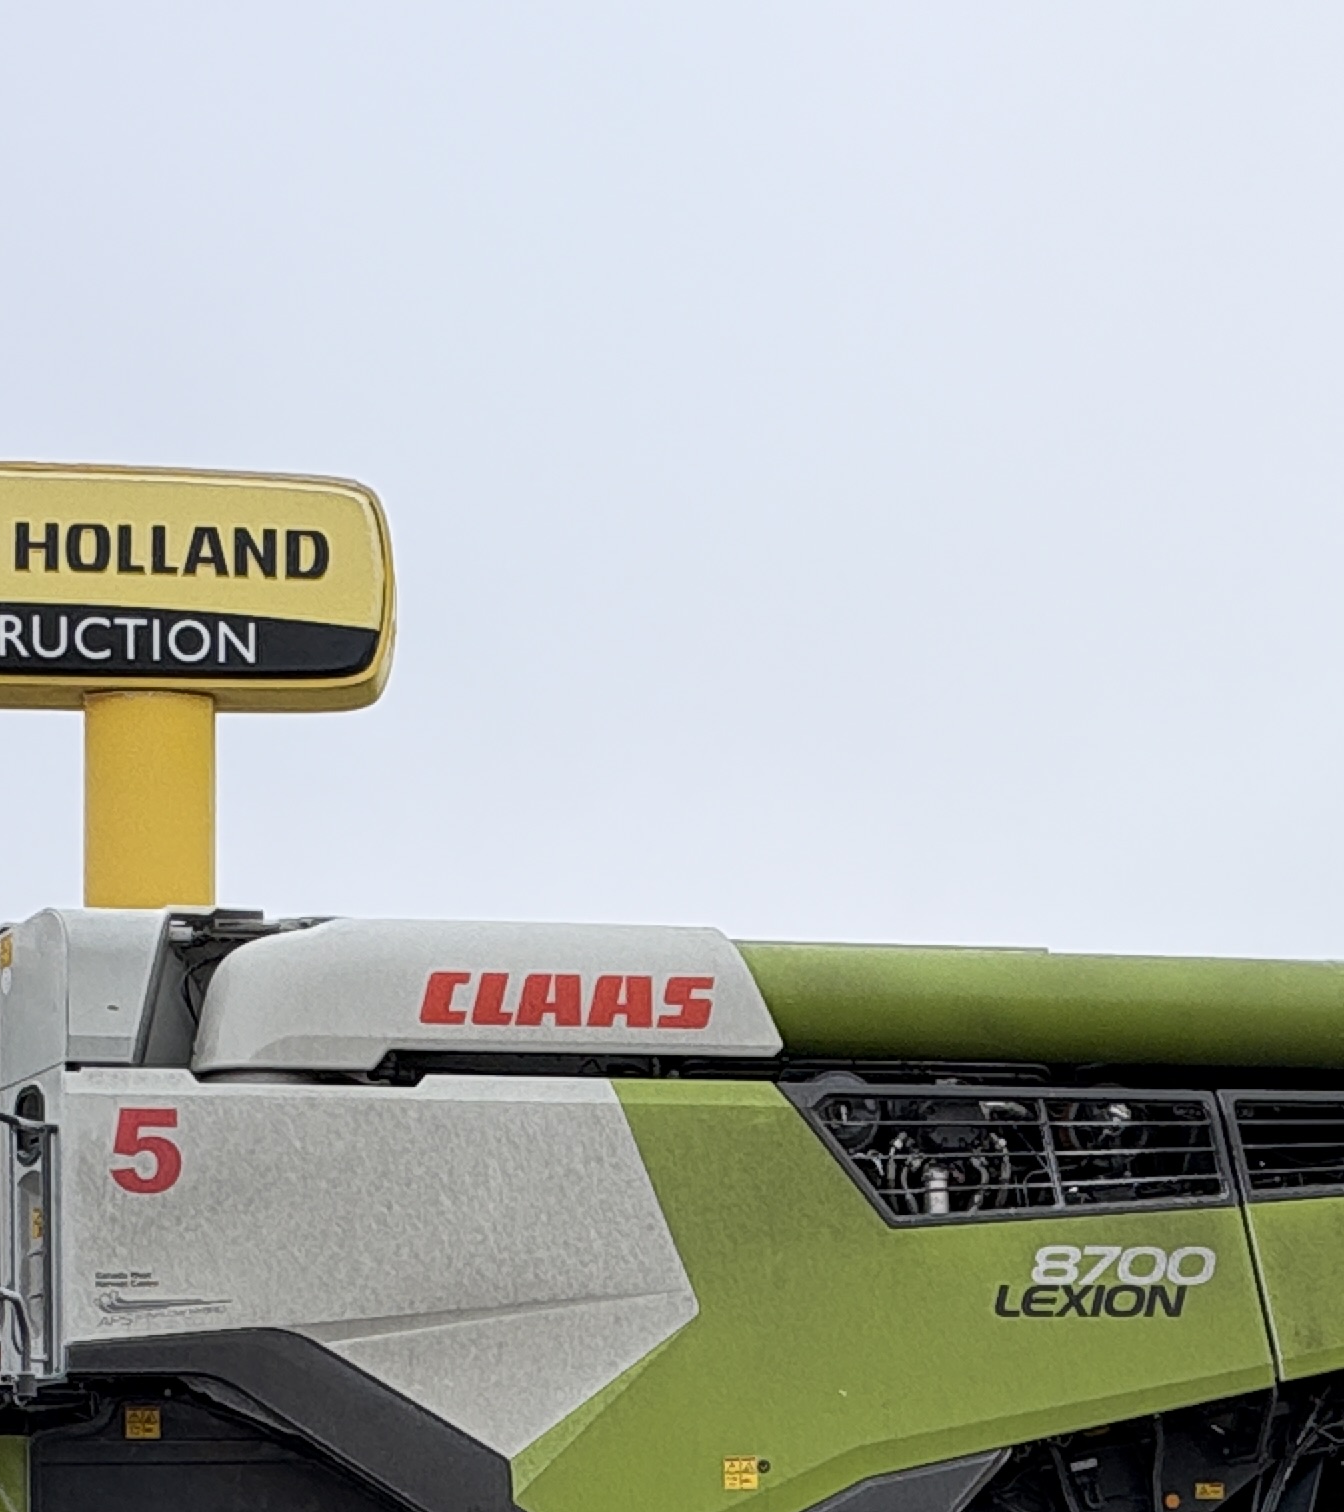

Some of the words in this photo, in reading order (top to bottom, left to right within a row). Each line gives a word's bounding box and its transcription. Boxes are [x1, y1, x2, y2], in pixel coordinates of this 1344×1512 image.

[14, 521, 330, 580] HOLLAND
[419, 971, 715, 1029] CLAAS
[109, 1108, 183, 1194] 5
[1031, 1245, 1216, 1286] 8700
[994, 1284, 1188, 1318] LEXION
